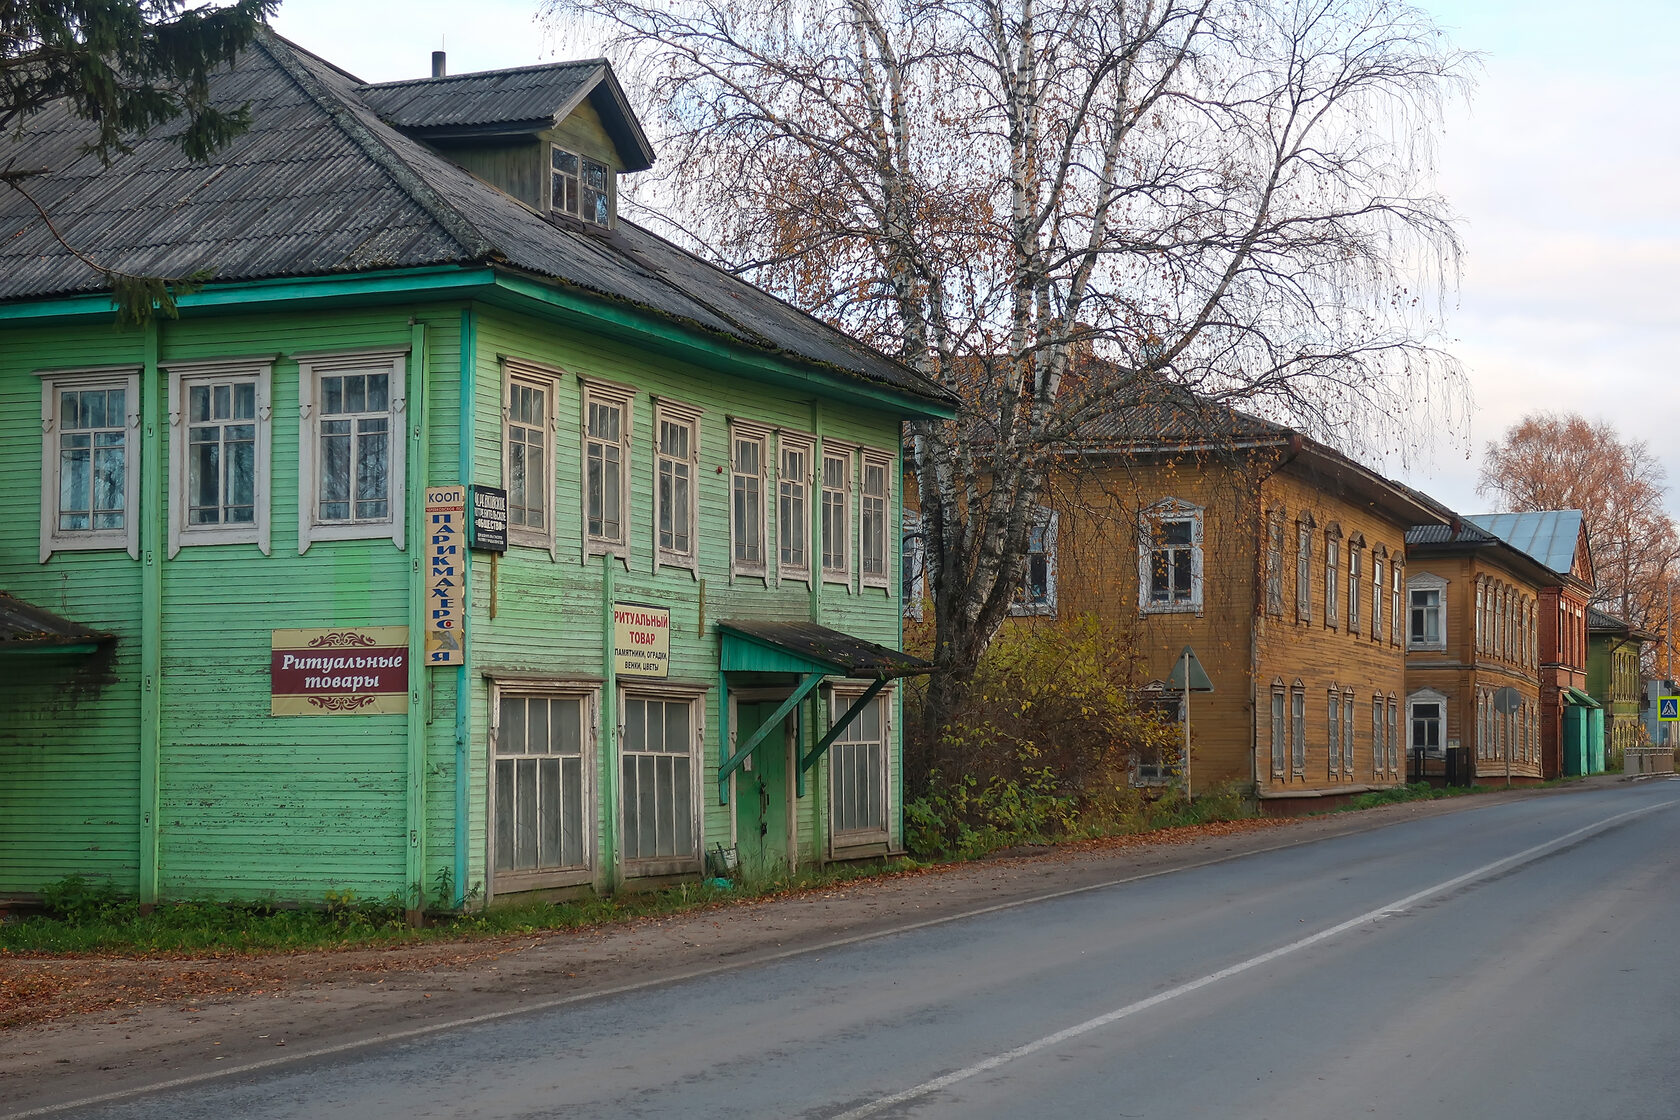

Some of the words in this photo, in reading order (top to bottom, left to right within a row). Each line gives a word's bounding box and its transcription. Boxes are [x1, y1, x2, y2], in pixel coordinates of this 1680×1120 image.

[428, 492, 460, 503] КООП
[477, 518, 503, 531] ОБЩЕСТВО
[431, 514, 457, 662] ПАРИКМАХЕРСЯ
[614, 611, 668, 628] РИТУАЛЬНЫЙ
[629, 631, 656, 645] ТОВАР
[614, 648, 646, 659] ПАМЯТНИКИ,
[281, 654, 403, 674] Ритуальные
[624, 661, 642, 671] ВЕНКИ,
[643, 662, 659, 671] ЦВЕТЫ
[305, 675, 380, 692] товары
